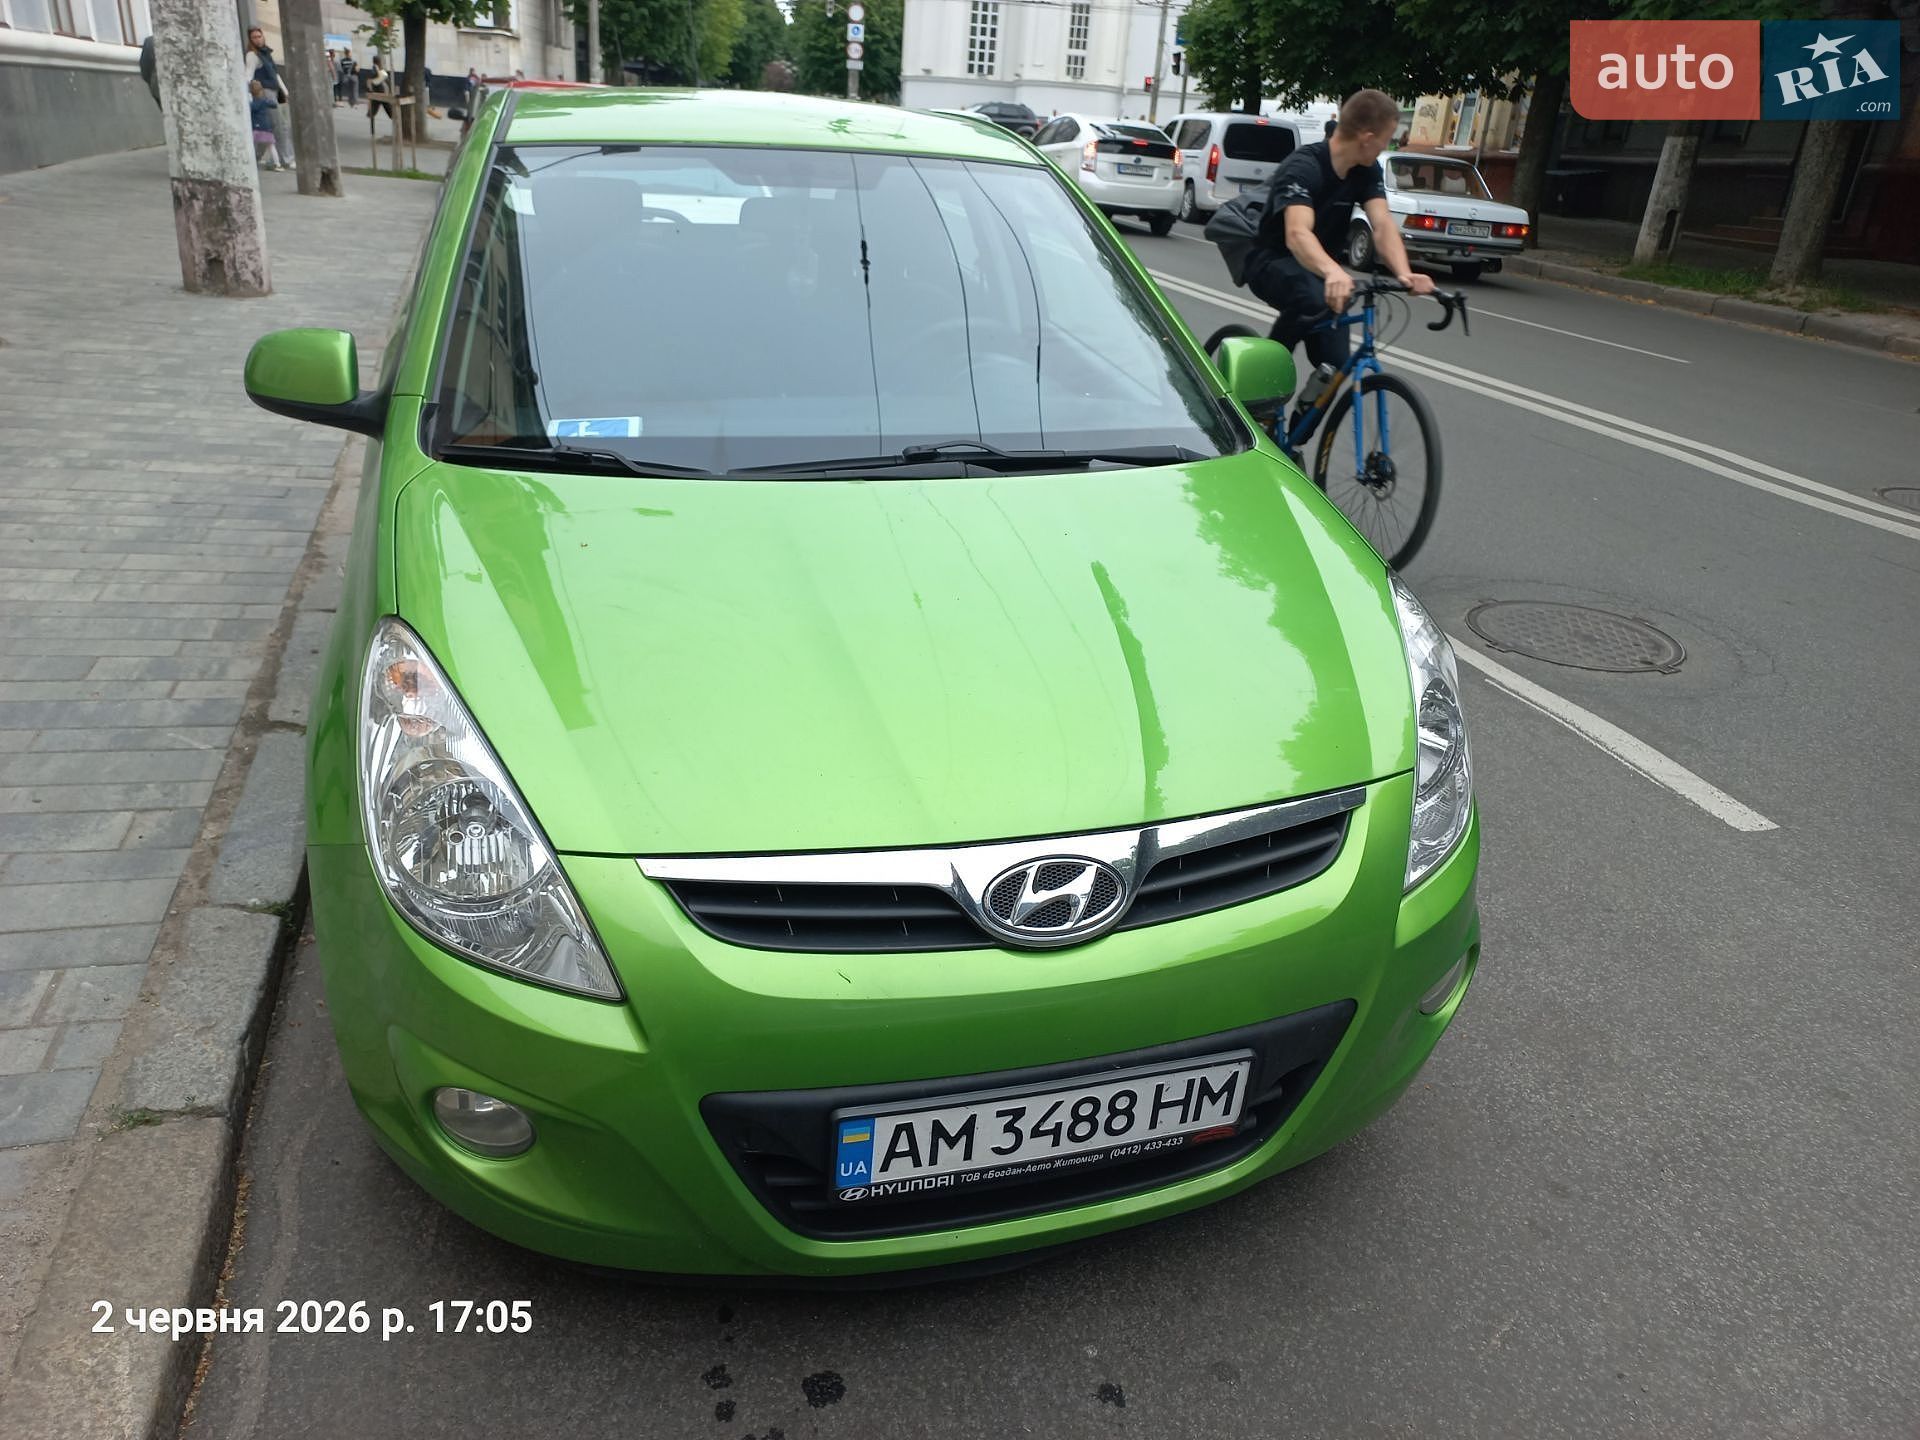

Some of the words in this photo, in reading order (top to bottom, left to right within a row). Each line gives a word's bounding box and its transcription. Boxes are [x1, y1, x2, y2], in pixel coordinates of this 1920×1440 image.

[878, 1113, 978, 1173] AM
[991, 1089, 1138, 1156] 3488
[1149, 1070, 1240, 1130] HM
[840, 1160, 868, 1177] UA
[960, 1172, 981, 1183] ТОВ
[1109, 1144, 1142, 1160] (0412)
[1144, 1136, 1184, 1152] 433-433
[871, 1174, 955, 1197] HYUNDAI
